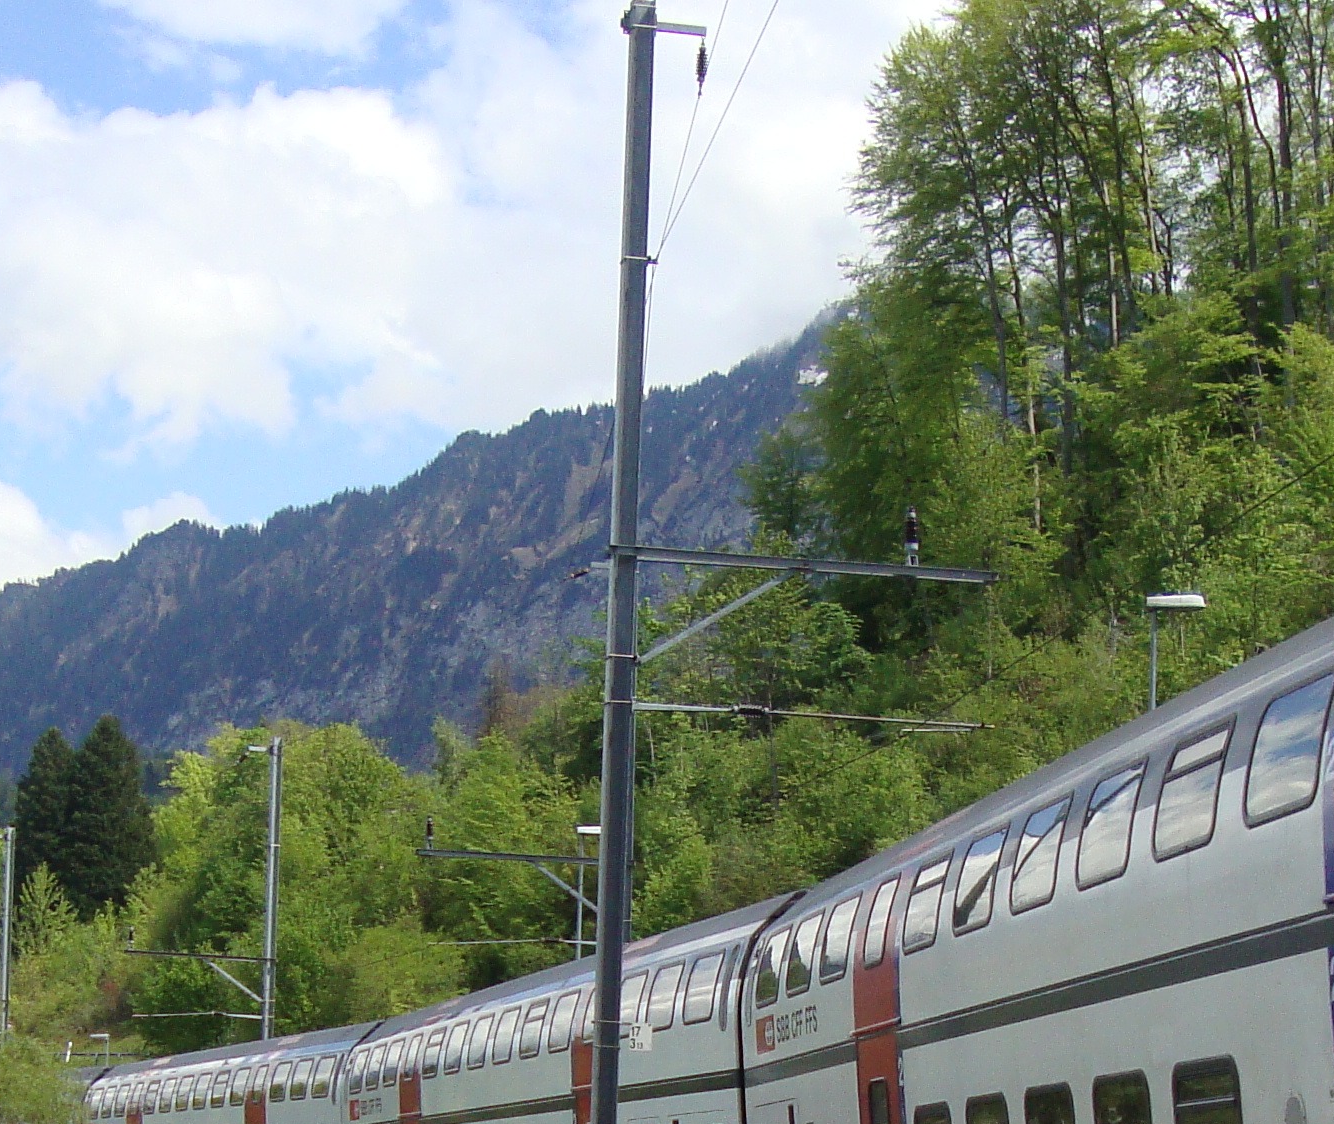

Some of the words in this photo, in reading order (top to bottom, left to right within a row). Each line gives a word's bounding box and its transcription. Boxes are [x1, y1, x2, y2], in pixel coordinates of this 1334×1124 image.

[631, 1026, 641, 1037] 17
[777, 1014, 790, 1043] SBB
[805, 1005, 818, 1033] FFS
